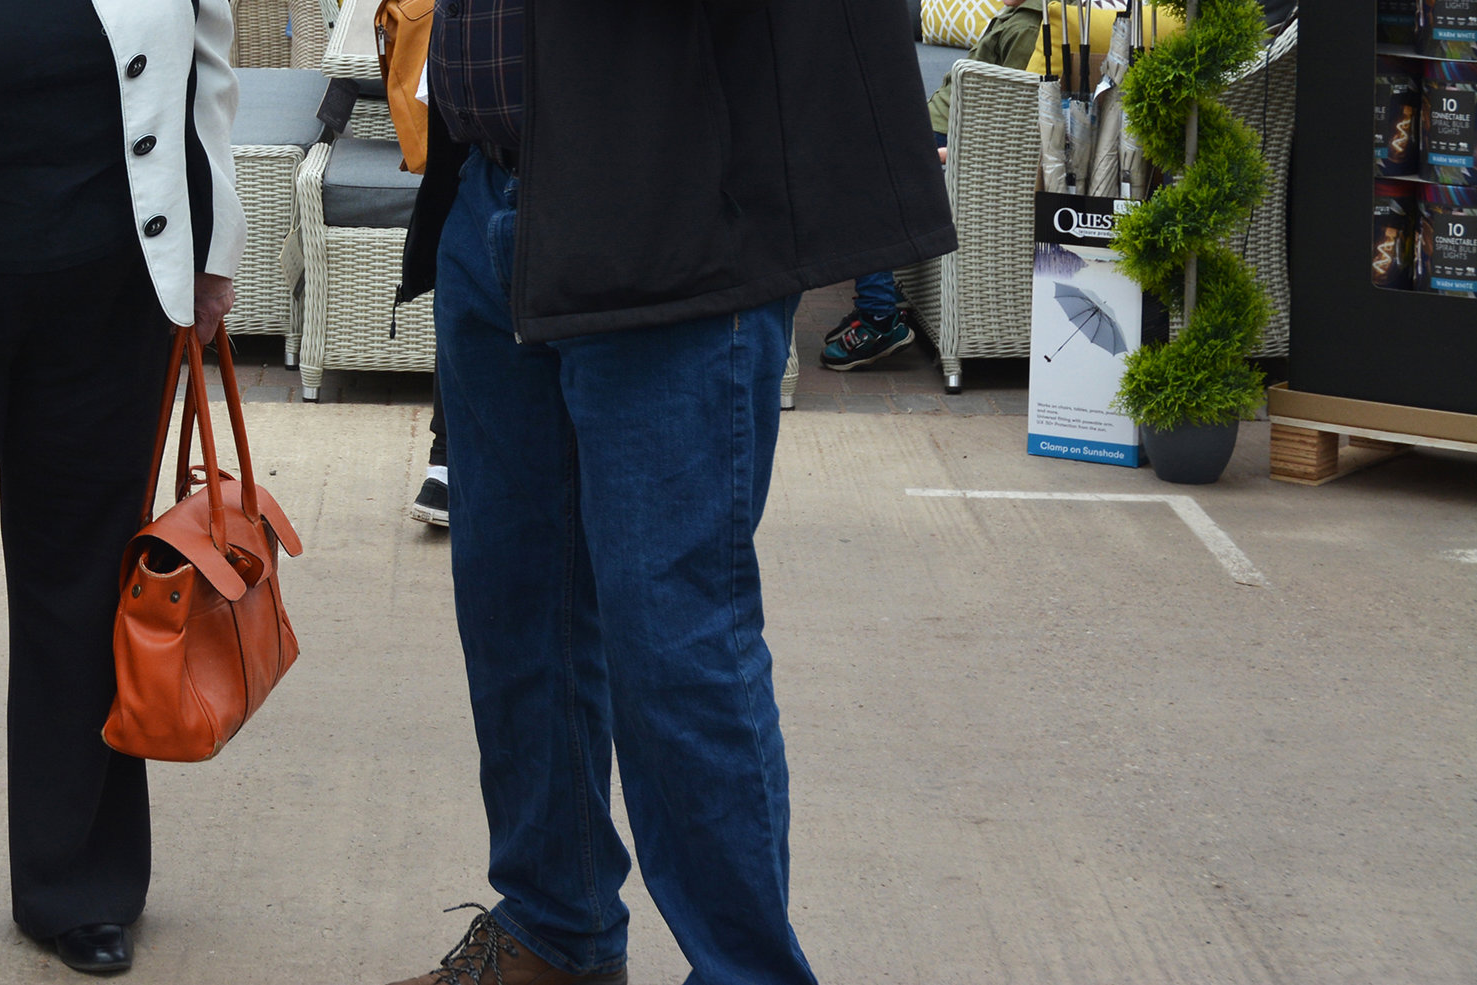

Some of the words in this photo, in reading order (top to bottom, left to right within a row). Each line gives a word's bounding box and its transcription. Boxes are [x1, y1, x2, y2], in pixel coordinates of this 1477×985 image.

[1445, 2, 1469, 10] LIGHTS
[1442, 98, 1458, 112] 10
[1432, 112, 1470, 121] CONNECTABLE
[1448, 222, 1464, 236] 10
[1040, 441, 1068, 454] Clamp
[1070, 446, 1081, 454] on
[1083, 446, 1124, 459] Sunshade
